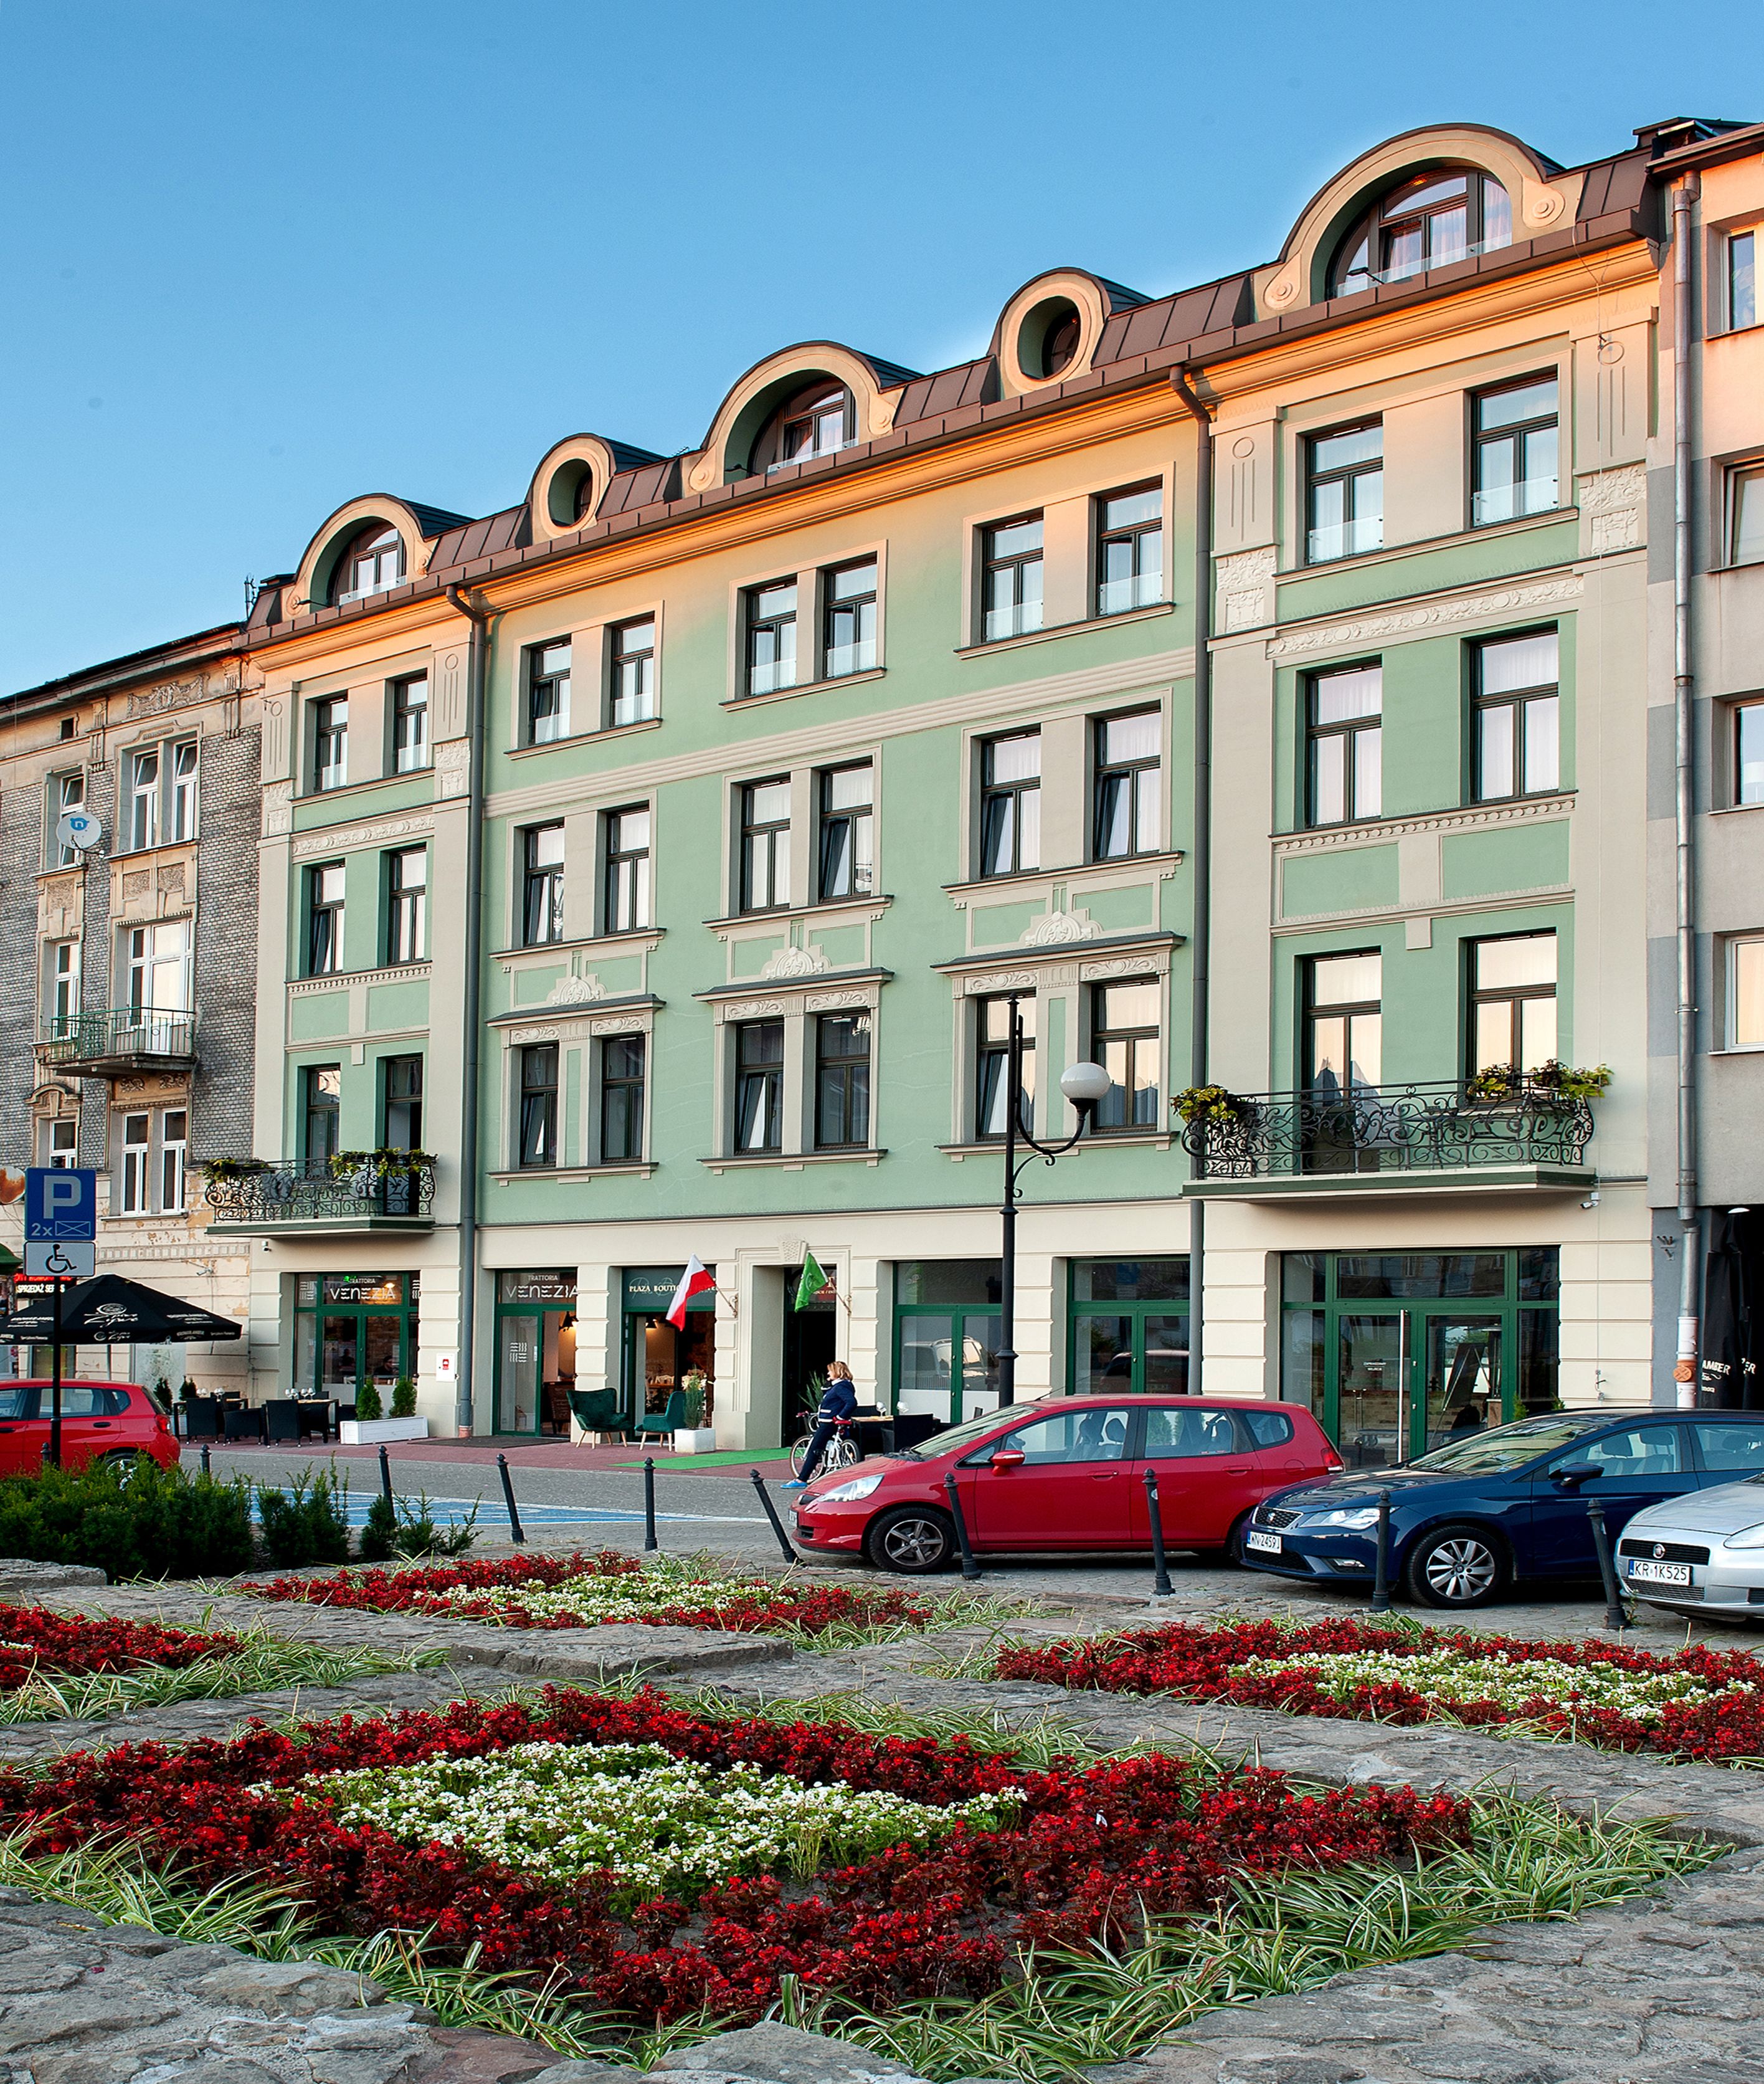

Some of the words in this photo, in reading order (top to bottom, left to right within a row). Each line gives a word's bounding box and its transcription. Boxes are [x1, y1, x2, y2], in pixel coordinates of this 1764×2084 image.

[43, 1175, 82, 1219] P
[31, 1222, 53, 1236] 2x
[330, 1287, 396, 1300] VENEZIA
[505, 1285, 578, 1298] VENEZIA
[1635, 1562, 1649, 1577] KR
[1654, 1564, 1687, 1581] 1K525
